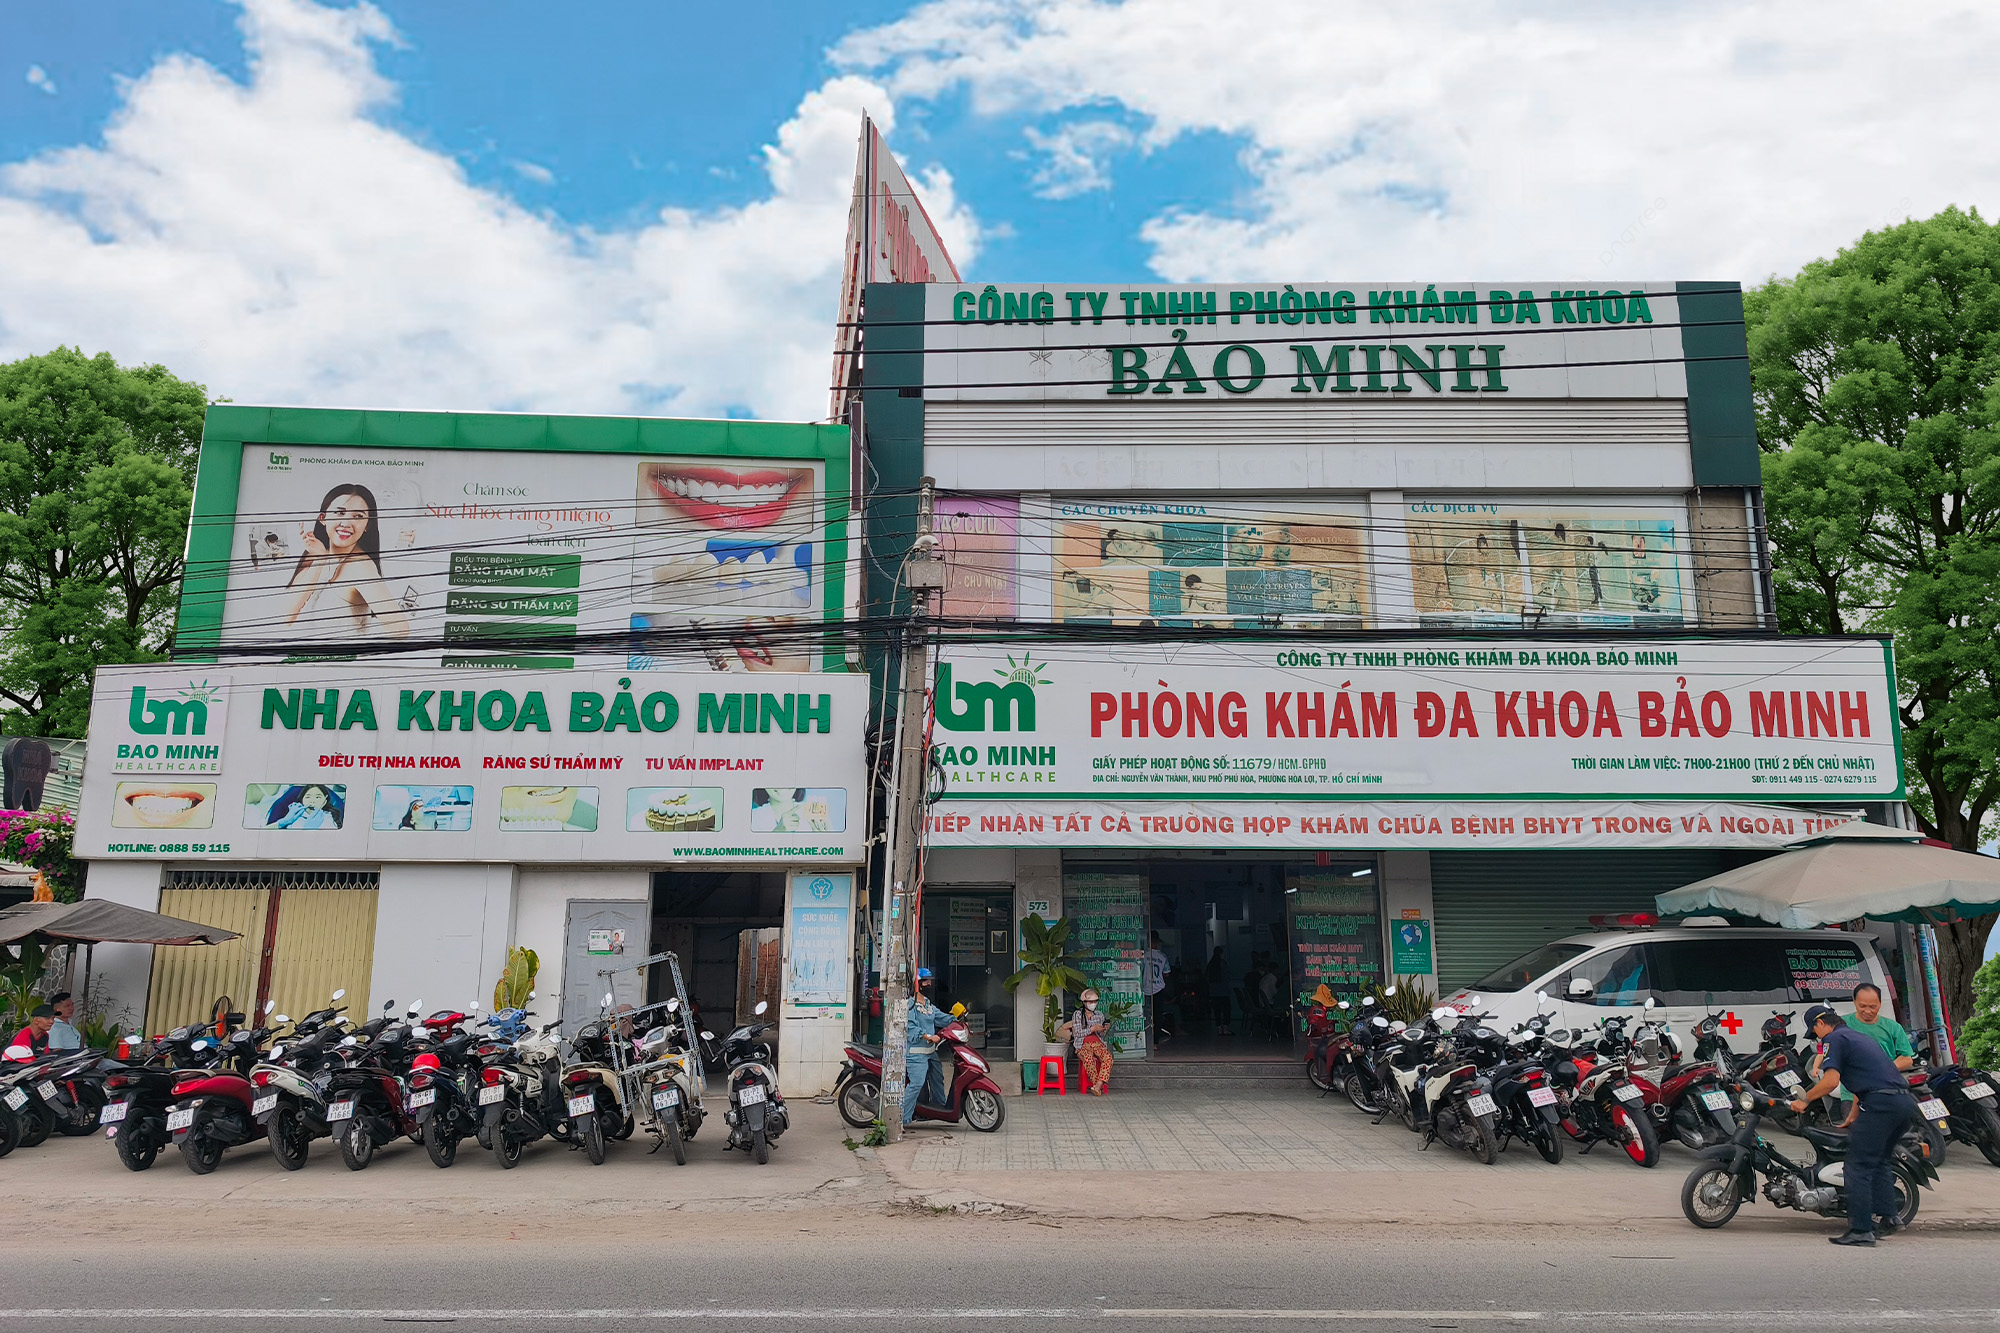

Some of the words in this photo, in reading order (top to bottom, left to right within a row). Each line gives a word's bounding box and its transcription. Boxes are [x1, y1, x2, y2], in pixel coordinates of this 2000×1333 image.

[953, 285, 1054, 325] CÔNG
[1065, 291, 1108, 325] TY
[1120, 291, 1217, 325] TNHH
[1230, 284, 1355, 324] PHÒNG
[1369, 284, 1477, 324] KHÁM
[1489, 290, 1540, 324] ĐA
[1551, 289, 1653, 323] KHOA
[1106, 328, 1266, 395] BẢO
[1290, 344, 1509, 393] MINH
[1098, 503, 1158, 516] CHUYÊN
[1164, 505, 1207, 515] KHOA
[1411, 501, 1438, 514] CÁC
[1443, 503, 1477, 515] DỊCH
[528, 566, 556, 578] MẶT
[1276, 649, 1322, 667] CÔNG
[1327, 652, 1347, 667] TY
[1352, 652, 1397, 667] TNHH
[1403, 647, 1459, 666] PHÒNG
[1465, 647, 1513, 666] KHÁM
[1518, 651, 1541, 666] ĐA
[1546, 651, 1591, 666] KHOA
[1596, 646, 1629, 666] BẢO
[1635, 651, 1678, 666] MINH
[260, 687, 378, 730] NHA
[396, 688, 551, 732] KHOA
[569, 677, 679, 733] BẢO
[697, 692, 831, 733] MINH
[1090, 679, 1248, 738] PHÒNG
[1265, 679, 1397, 738] KHÁM
[1413, 691, 1479, 738] ĐA
[1496, 691, 1622, 738] KHOA
[1637, 676, 1732, 738] BẢO
[1749, 690, 1871, 738] MINH
[165, 744, 219, 759] MINH
[986, 745, 1056, 766] MINH
[115, 762, 218, 771] HEALTHCARE
[318, 752, 354, 768] ĐIỀU
[357, 755, 382, 771] TRỊ
[384, 756, 416, 769] NHA
[419, 757, 461, 769] KHOA
[482, 754, 526, 770] RĂNG
[530, 753, 551, 770] SỨ
[554, 751, 597, 770] THẨM
[600, 754, 623, 770] MỸ
[645, 757, 664, 771] TƯ
[668, 754, 696, 771] VẤN
[699, 758, 764, 771] IMPLANT
[1092, 754, 1116, 769] GIẤY
[1119, 755, 1148, 769] PHÉP
[1150, 757, 1178, 771] HOẠT
[1180, 755, 1210, 771] ĐỘNG
[1212, 754, 1230, 769] SỐ:
[1571, 754, 1596, 769] THỜI
[1599, 757, 1624, 769] GIAN
[1627, 754, 1651, 769] LÀM
[1653, 755, 1681, 771] VIỆC:
[1683, 757, 1751, 769] 7H00-21H00
[1754, 755, 1780, 770] (THỨ
[1782, 757, 1790, 769] 2
[1792, 754, 1814, 769] ĐẾN
[1817, 754, 1840, 769] CHỦ
[1842, 755, 1875, 771] NHẬT)
[1092, 774, 1104, 784] ĐỊA
[1121, 772, 1148, 783] NGUYỄN
[1150, 773, 1164, 783] VĂN
[1192, 774, 1207, 783] KHU
[1208, 772, 1223, 783] PHỐ
[1319, 775, 1330, 783] TP.
[1751, 775, 1768, 783] SĐT:
[1769, 775, 1787, 783] 0911
[1788, 775, 1803, 783] 449
[1804, 775, 1818, 783] 115
[1824, 775, 1842, 783] 0274
[1843, 775, 1862, 783] 6279
[1863, 775, 1877, 783] 115
[980, 812, 1044, 836] NHẬN
[1053, 811, 1092, 832] TẤT
[1101, 810, 1130, 833] CẢ
[1139, 811, 1234, 833] TRƯỜNG
[1243, 814, 1291, 837] HỢP
[1301, 812, 1369, 834] KHÁM
[1377, 813, 1443, 834] CHỮA
[1451, 812, 1514, 837] BỆNH
[1523, 816, 1582, 834] BHYT
[1591, 815, 1672, 834] TRONG
[1680, 812, 1713, 834] VÀ
[1720, 813, 1795, 835] NGOÀI
[107, 842, 157, 854] HOTLINE:
[158, 843, 189, 854] 0888
[191, 843, 206, 854] 59
[207, 843, 230, 854] 115
[673, 845, 844, 857] WWW.BAOMINHHEALTHCARE.COM
[1029, 901, 1048, 911] 573
[1788, 955, 1818, 970] BẢO
[1821, 958, 1859, 970] MINH
